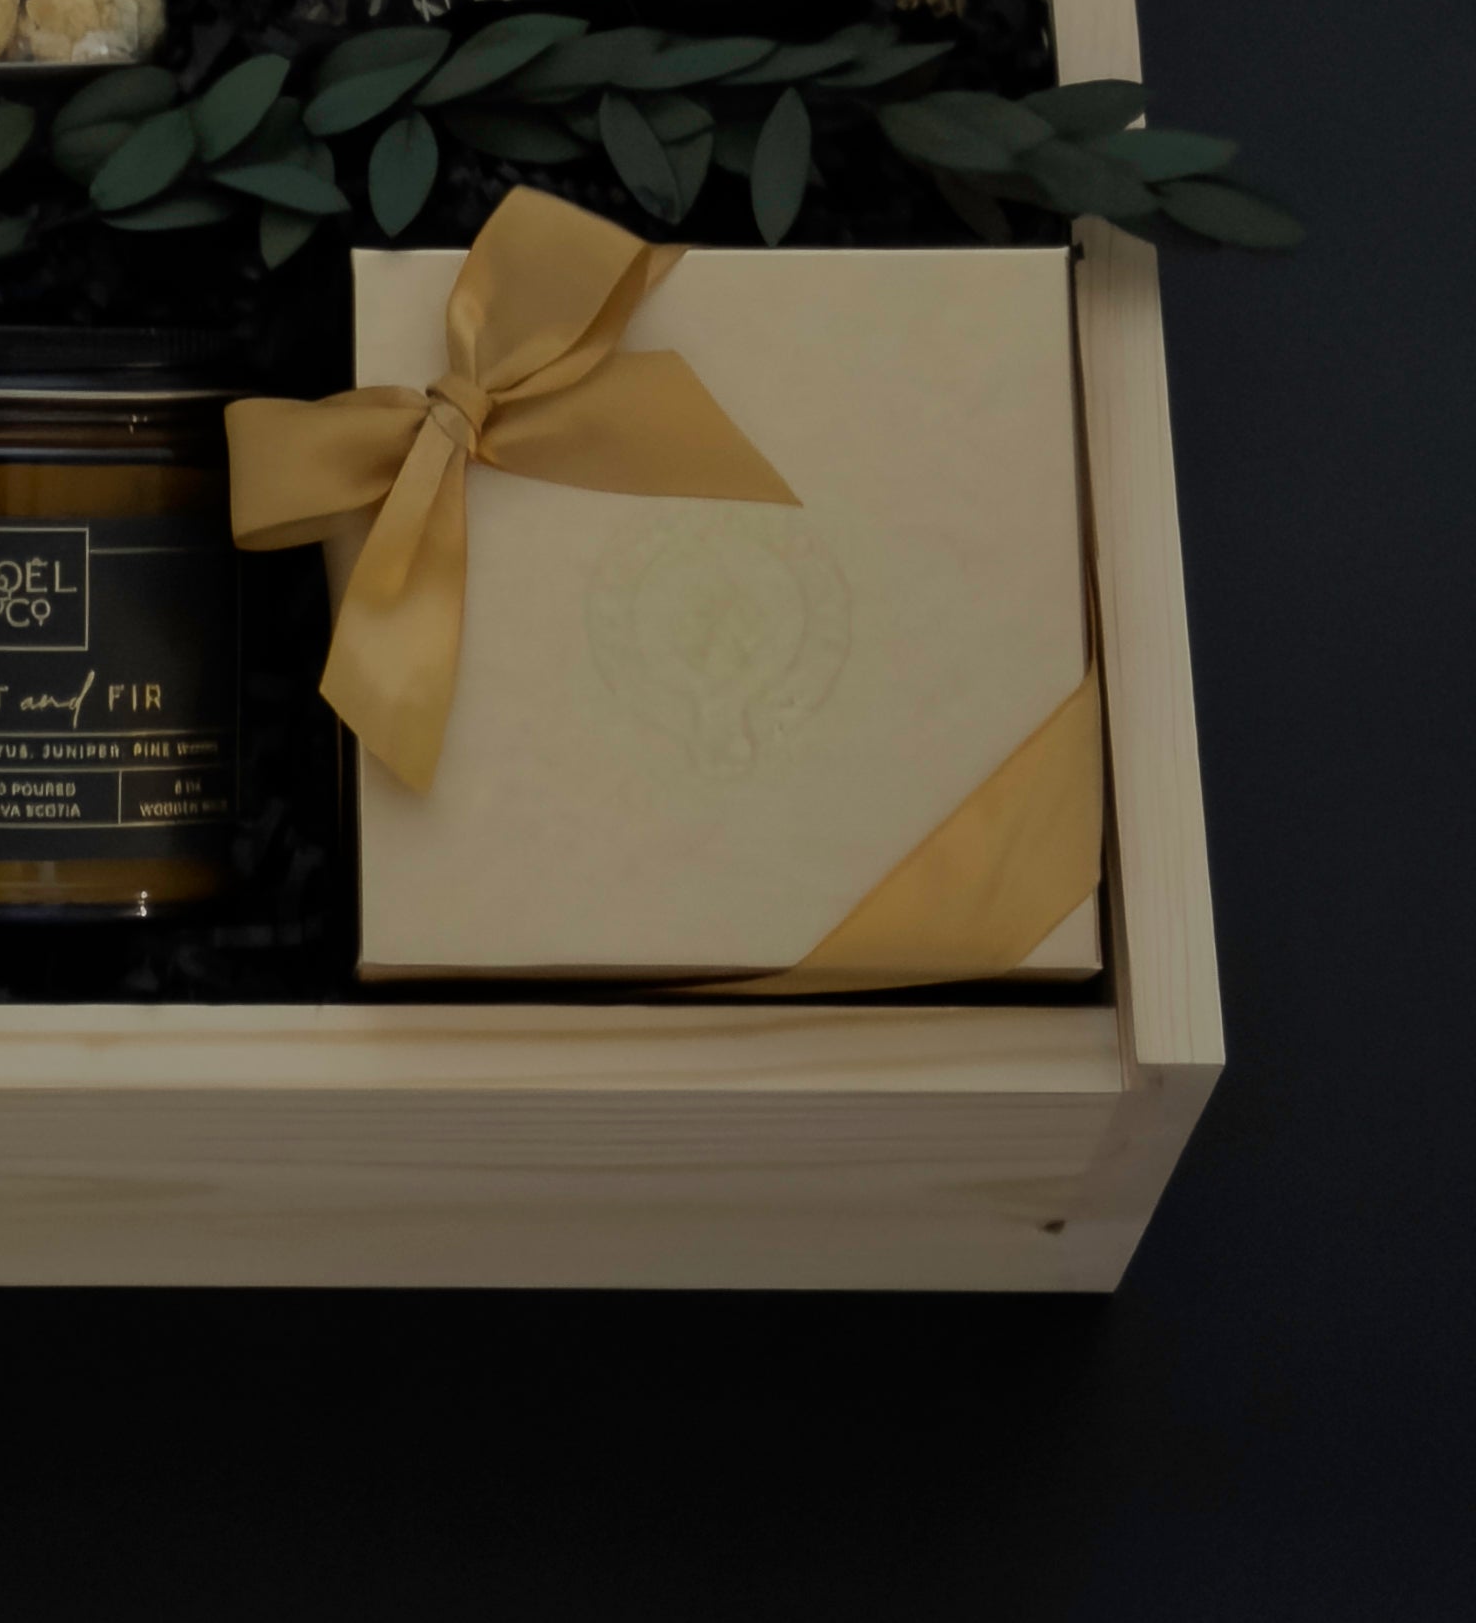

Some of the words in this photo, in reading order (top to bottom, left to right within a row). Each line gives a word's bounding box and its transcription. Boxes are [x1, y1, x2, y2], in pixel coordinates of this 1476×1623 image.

[17, 669, 96, 730] and
[106, 683, 162, 713] FIR
[11, 781, 76, 799] POURED
[24, 802, 82, 819] SCOTIA
